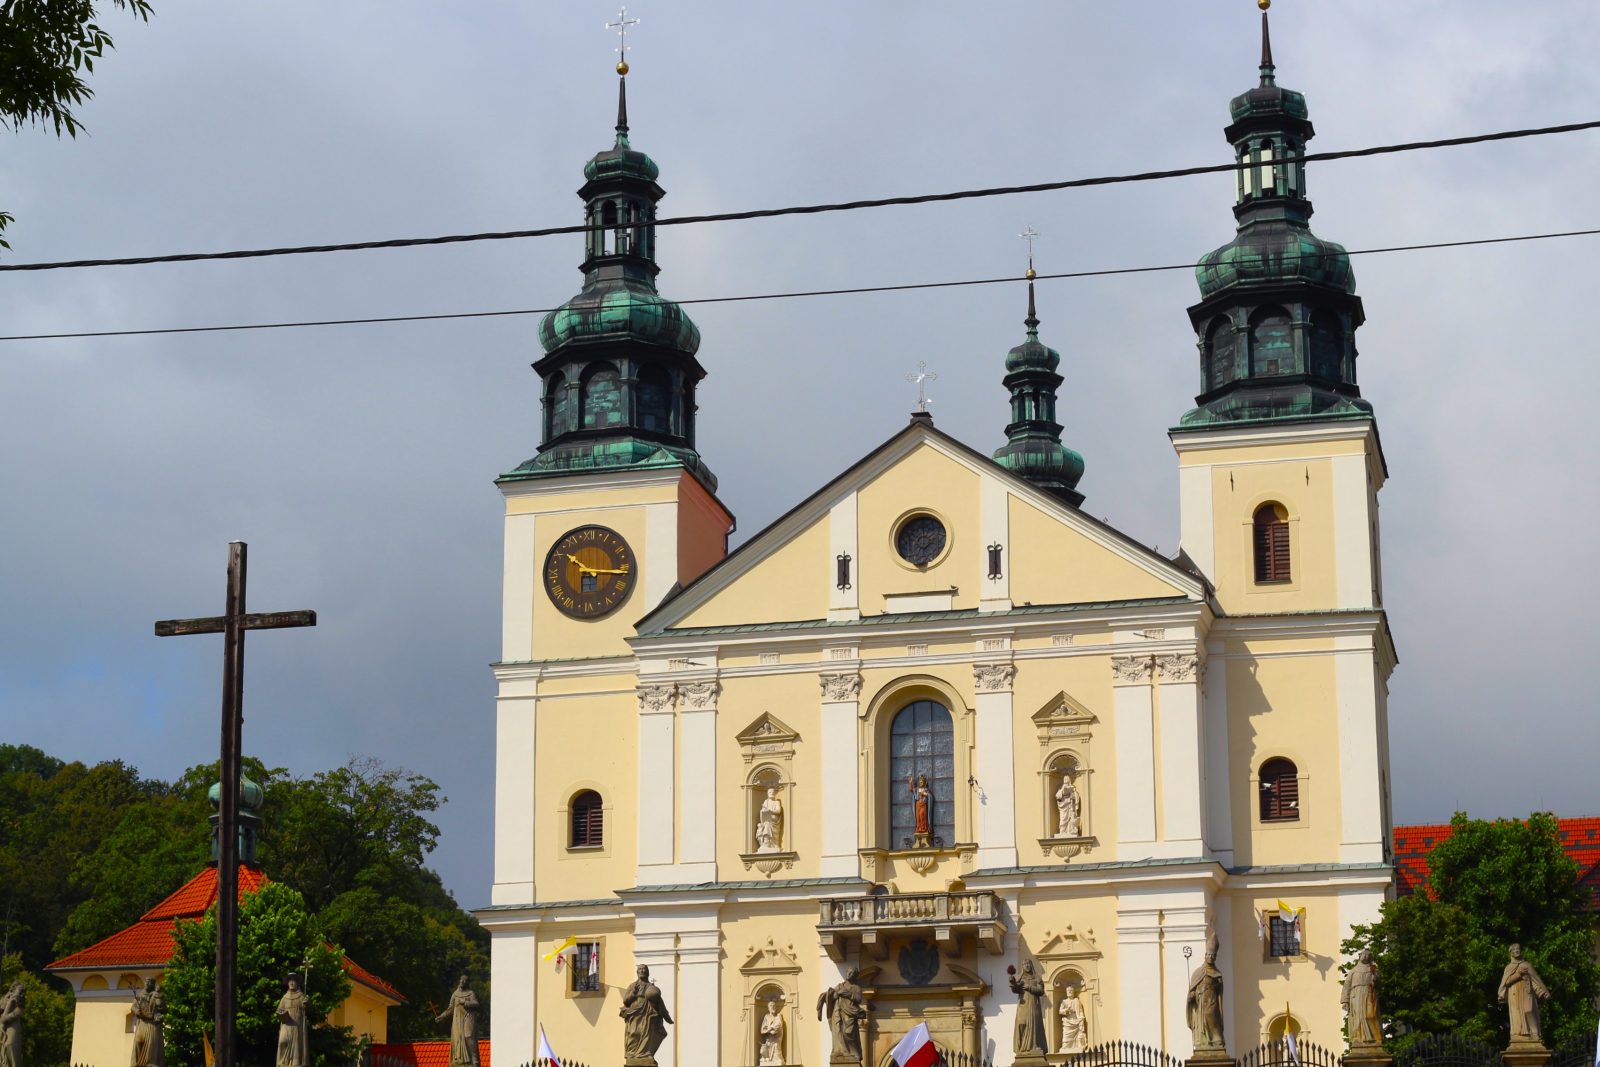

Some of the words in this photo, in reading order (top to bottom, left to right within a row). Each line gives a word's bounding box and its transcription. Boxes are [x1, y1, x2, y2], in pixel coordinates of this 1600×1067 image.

[583, 530, 595, 541] XII
[565, 535, 578, 547] XI
[553, 550, 564, 559] X
[614, 545, 625, 554] II
[548, 568, 559, 579] IX
[563, 597, 574, 609] VII
[605, 596, 613, 605] V
[584, 602, 593, 612] VI
